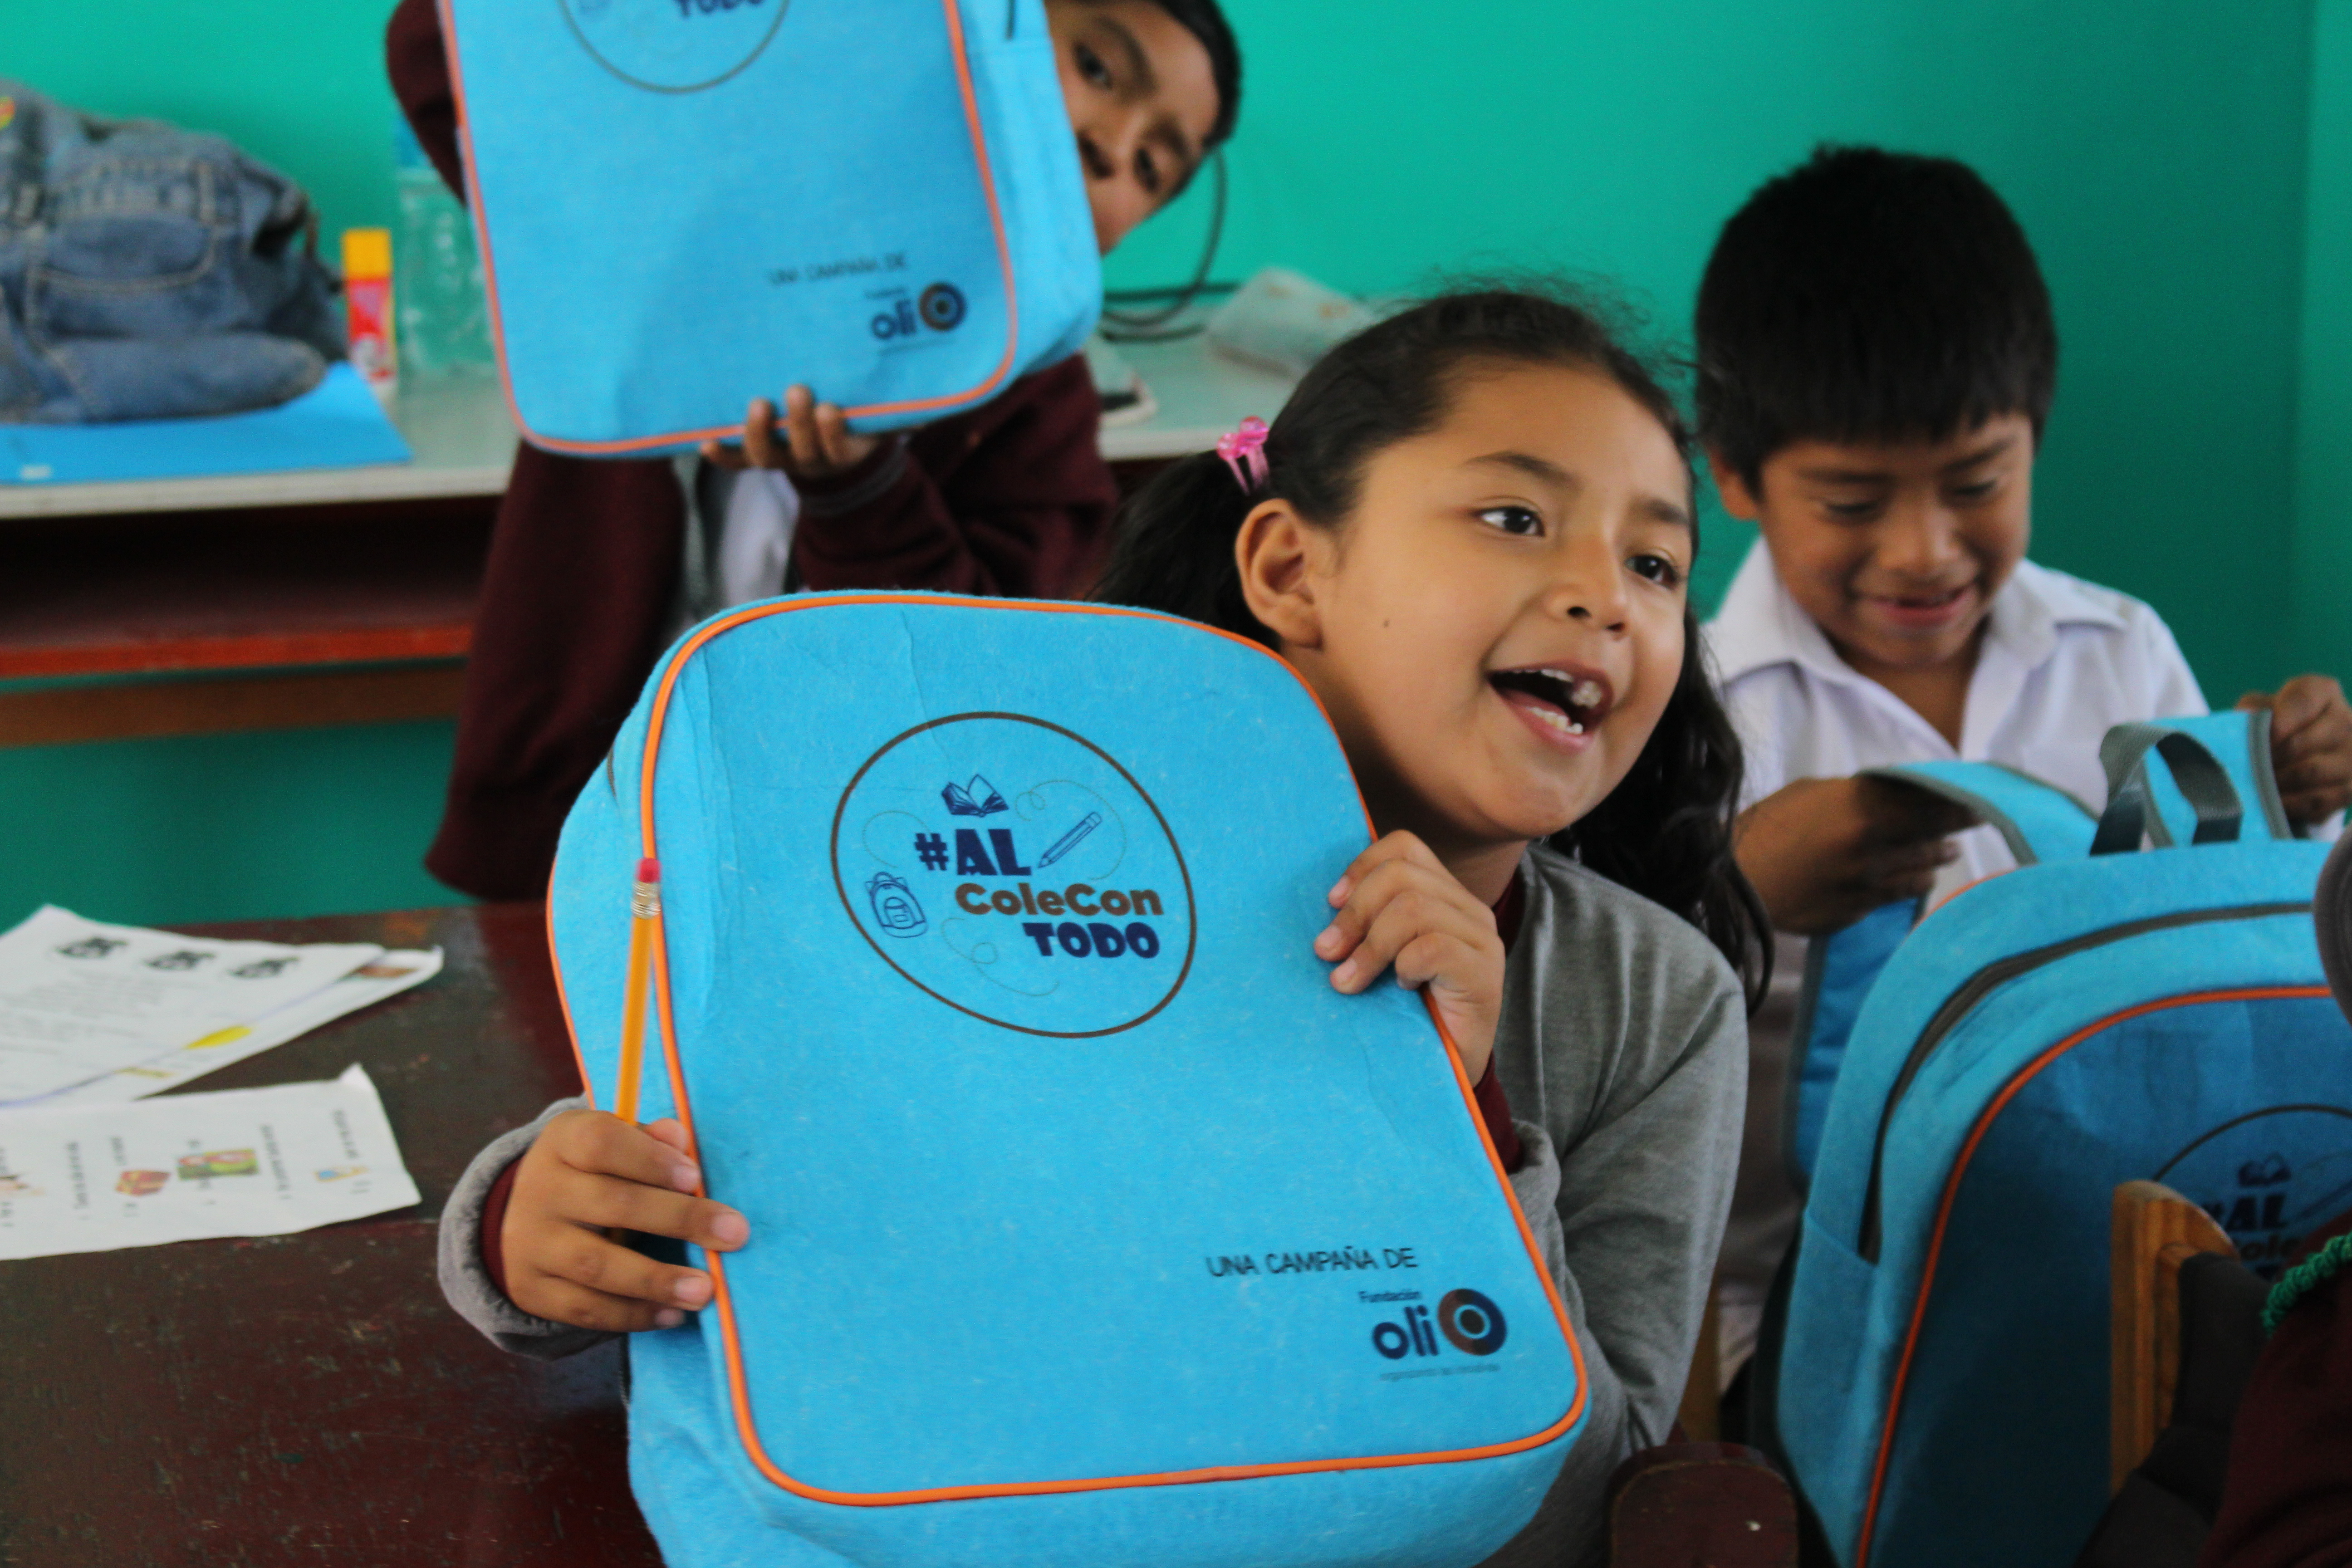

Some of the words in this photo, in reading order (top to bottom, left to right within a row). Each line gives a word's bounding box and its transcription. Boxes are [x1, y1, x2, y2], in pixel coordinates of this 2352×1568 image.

[914, 828, 1033, 876] #AL
[954, 882, 1164, 916] ColeCon
[1022, 922, 1160, 959] TODO
[1205, 1254, 1260, 1277] UNA
[1265, 1245, 1379, 1274] CAMPAÑA
[1382, 1247, 1419, 1269] DE
